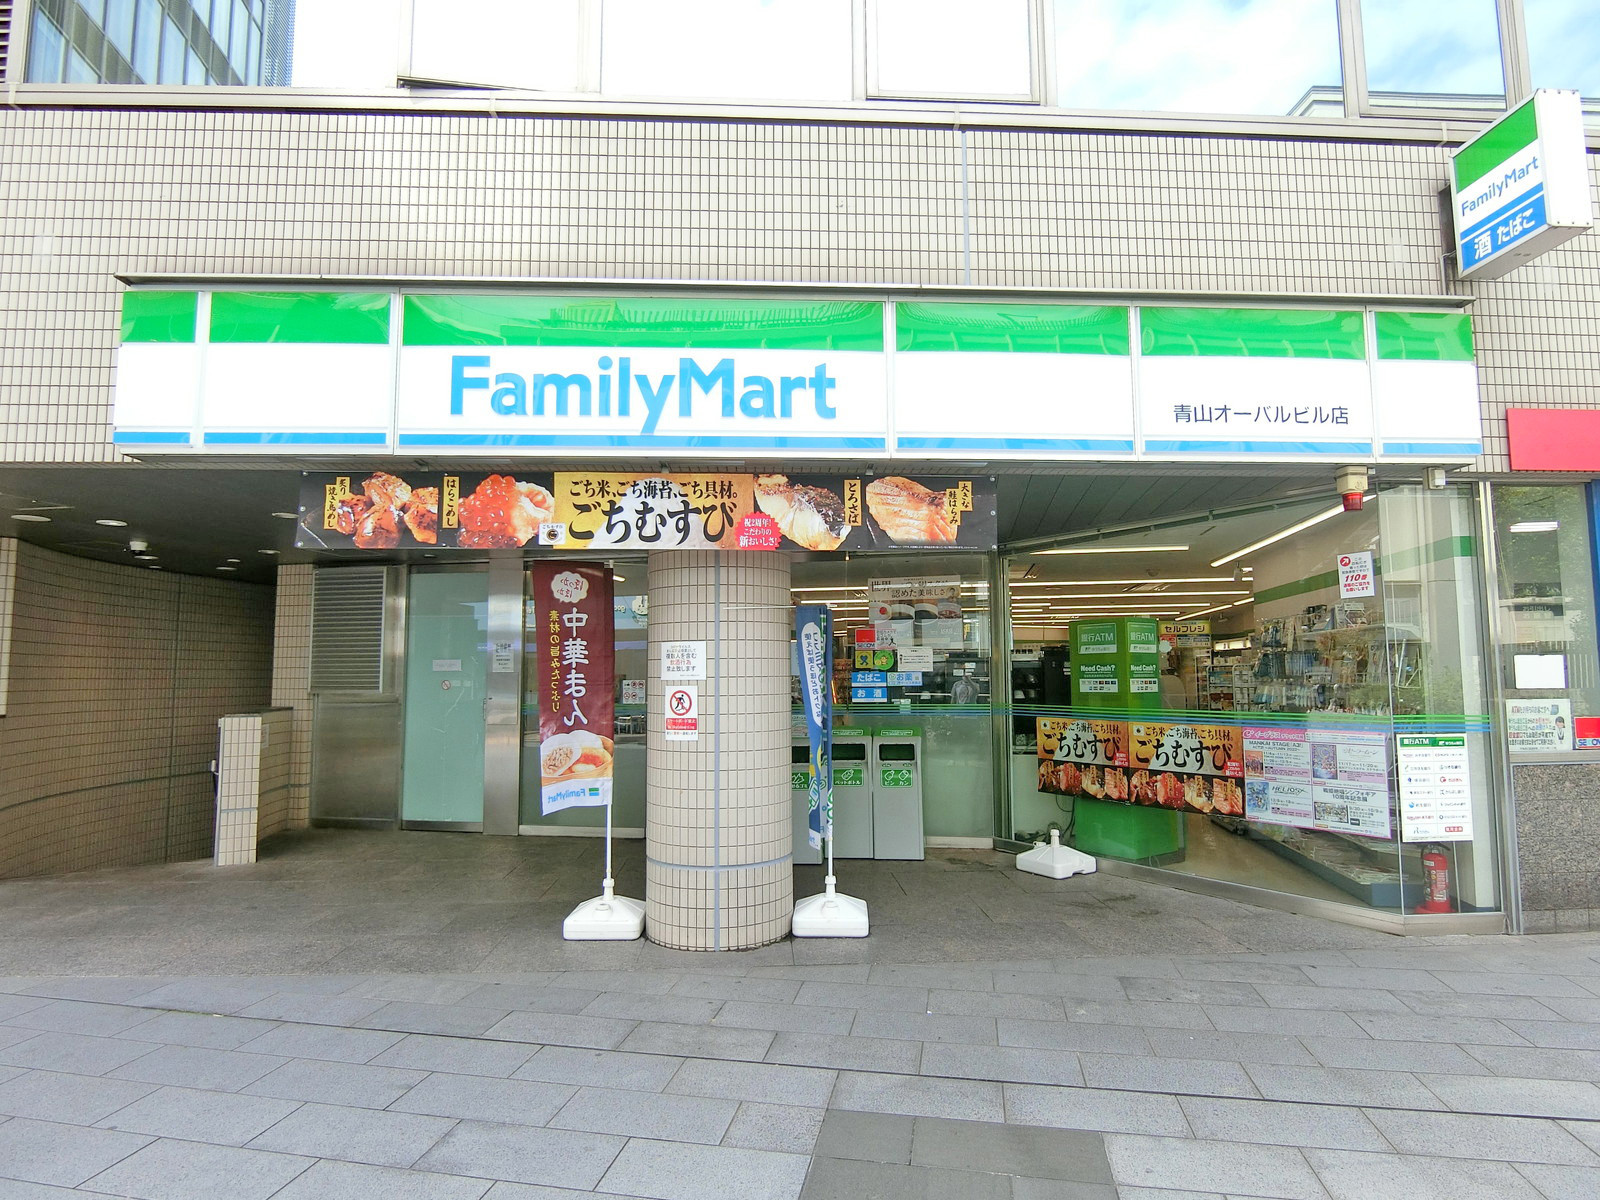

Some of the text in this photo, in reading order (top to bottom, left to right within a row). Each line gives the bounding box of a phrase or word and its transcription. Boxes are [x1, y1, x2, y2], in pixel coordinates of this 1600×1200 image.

[1461, 156, 1539, 217] FamilyMart
[1473, 208, 1536, 260] 酒 たばこ
[450, 355, 837, 435] FamilyMart
[1173, 404, 1349, 425] 青山オーバルビル店
[445, 478, 458, 528] はらこめし
[569, 480, 738, 500] ごち米、ごち海苔、ごち具材。
[847, 481, 859, 524] とろさば
[961, 483, 970, 509] 大きな
[568, 500, 738, 546] ごちむすび
[948, 490, 959, 525] 鮭はらみ
[744, 528, 772, 536] こだわりの
[1081, 633, 1114, 642] 銀行ATM
[1165, 625, 1205, 633] セルフレジ
[857, 673, 882, 682] たばこ
[1043, 732, 1121, 761] ごちむすび
[1136, 738, 1233, 771] ごちむすび
